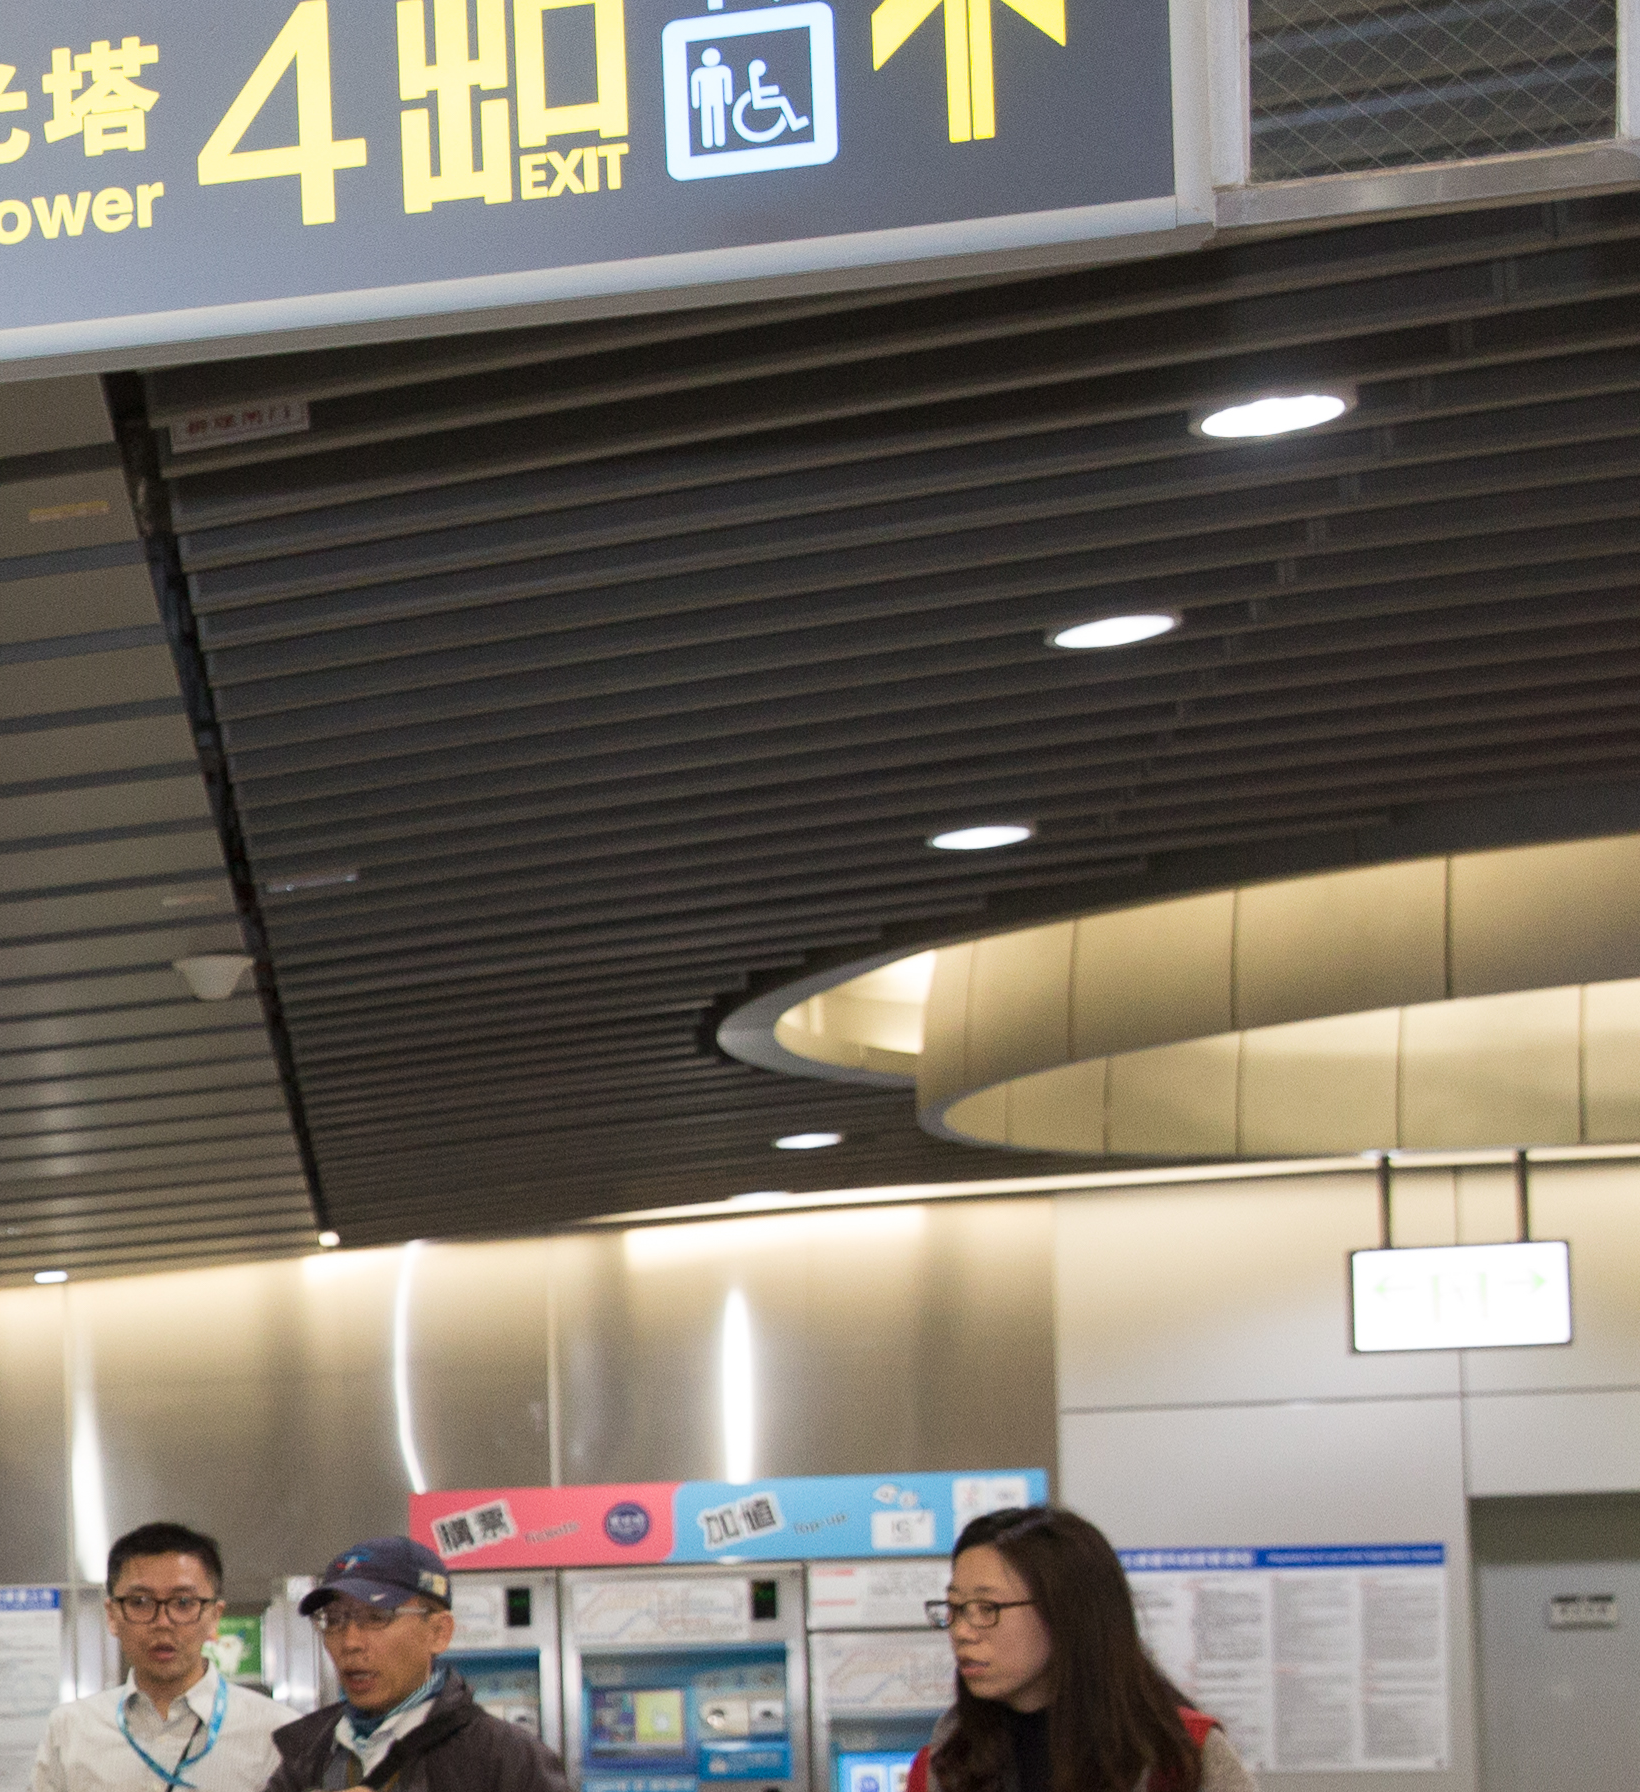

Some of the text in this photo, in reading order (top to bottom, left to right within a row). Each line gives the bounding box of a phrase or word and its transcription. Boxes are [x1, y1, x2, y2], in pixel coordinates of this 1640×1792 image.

[198, 0, 367, 226] 4
[396, 0, 629, 214] 出口
[520, 143, 628, 200] EXIT
[704, 1498, 777, 1548] 加值
